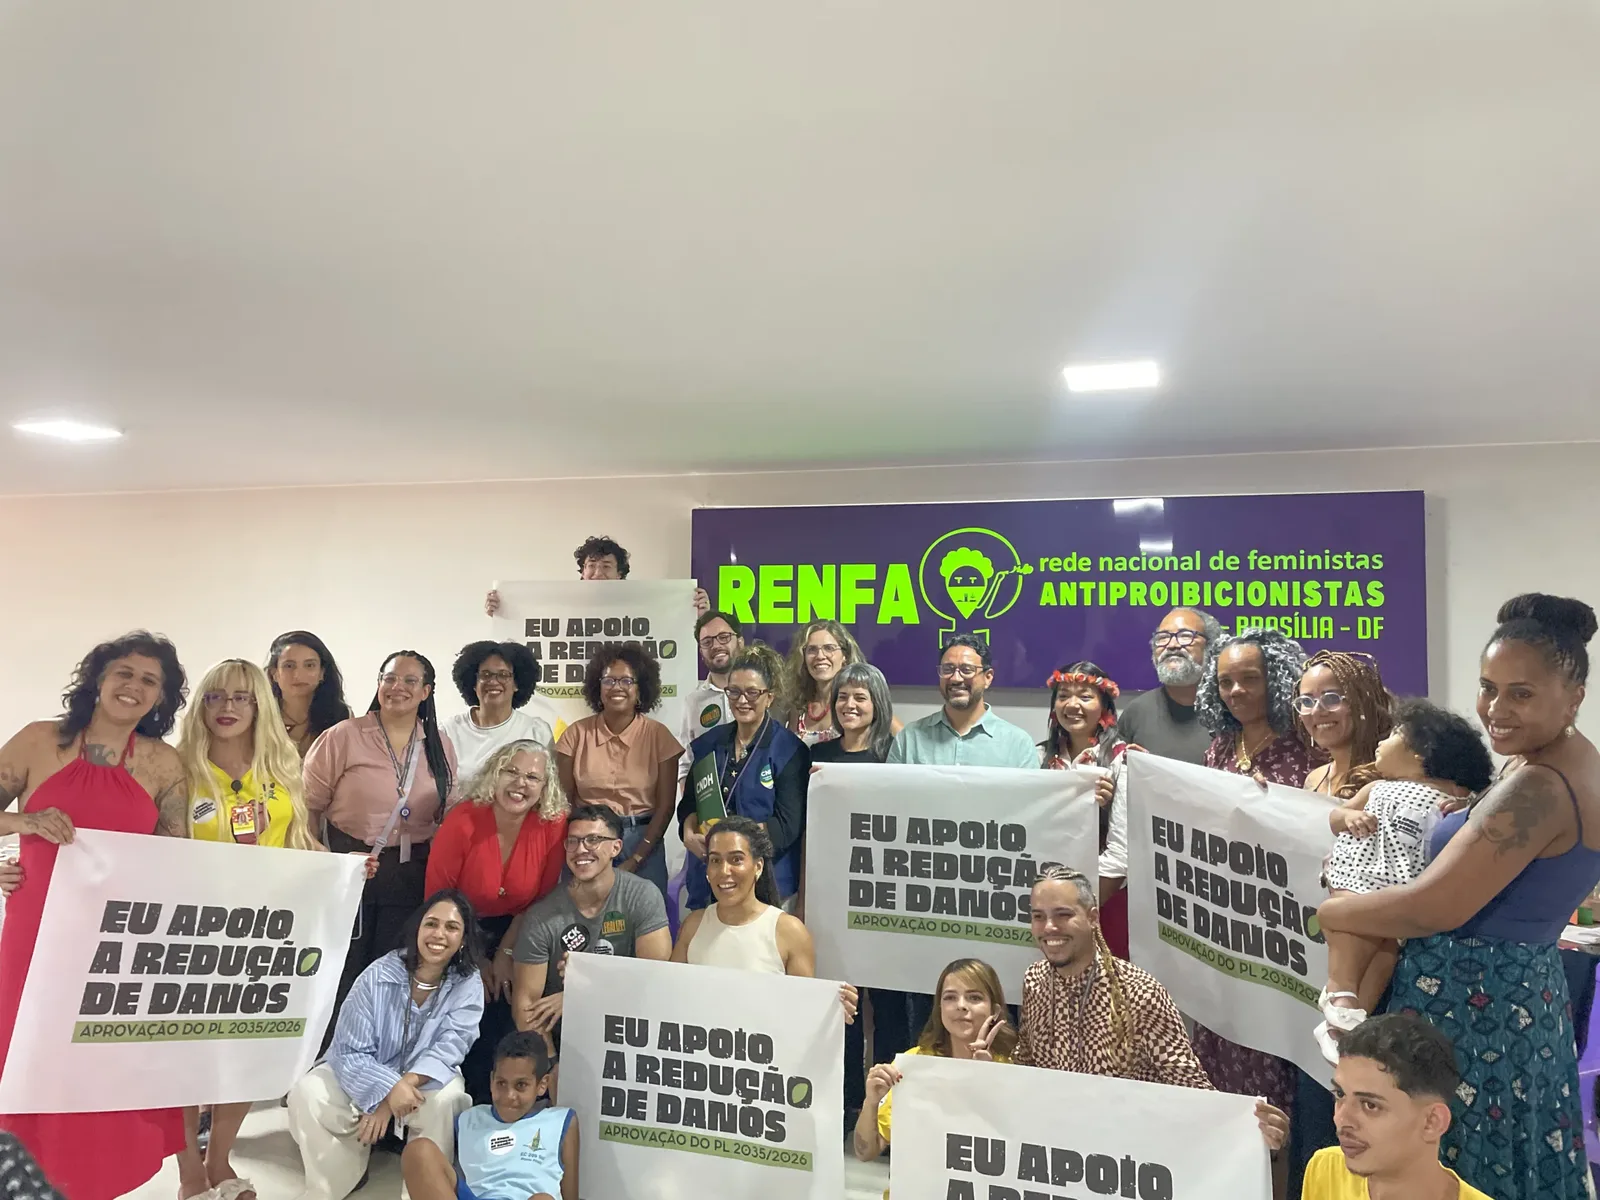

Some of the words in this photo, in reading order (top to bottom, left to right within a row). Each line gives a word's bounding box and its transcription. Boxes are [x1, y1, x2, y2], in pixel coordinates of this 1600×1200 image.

[1039, 551, 1091, 572] rede
[1099, 550, 1201, 571] nacional
[1208, 550, 1240, 571] de
[1247, 549, 1384, 570] feministas
[719, 564, 920, 624] RENFA
[1039, 580, 1385, 608] ANTIPROIBICIONISTAS
[525, 618, 560, 638] EU
[566, 615, 650, 638] APOIO
[1357, 616, 1384, 640] DF
[696, 773, 714, 793] CNDH
[850, 813, 897, 842] EU
[906, 817, 1027, 852] APOIO
[849, 846, 874, 874] A
[1152, 815, 1185, 853] EU
[1190, 828, 1288, 888] APOIO
[1154, 851, 1171, 885] A
[849, 879, 897, 910] DE
[100, 900, 163, 935] EU
[166, 905, 295, 940] APOIO
[561, 926, 581, 944] FCK
[853, 915, 937, 933] APROVAÇÃO
[941, 923, 961, 935] DO
[966, 925, 981, 937] PL
[1156, 887, 1188, 929] DE
[1193, 902, 1308, 976] DANOS
[88, 941, 123, 974] A
[130, 940, 323, 982] REDUÇÃO
[1161, 925, 1216, 962] APROVAÇÃO
[1217, 954, 1235, 971] DO
[1240, 962, 1257, 978] PL
[1261, 967, 1320, 1004] 2035/202
[79, 981, 143, 1015] DE
[147, 982, 291, 1014] DANOS
[79, 1020, 179, 1040] APROVAÇÃO
[182, 1022, 204, 1036] DO
[208, 1022, 224, 1035] PL
[228, 1020, 301, 1034] 2035/2026
[604, 1014, 649, 1048] EU
[657, 1021, 774, 1065] APOIO
[602, 1049, 627, 1081] A
[636, 1053, 813, 1109] REDUÇÃO
[601, 1085, 648, 1121] DE
[656, 1092, 787, 1143] DANOS
[604, 1125, 687, 1147] APROVAÇÃO
[690, 1136, 710, 1150] DO
[714, 1139, 731, 1153] PL
[734, 1143, 808, 1165] 2035/2026
[946, 1132, 1006, 1177] EU
[1017, 1142, 1173, 1200] APOIO
